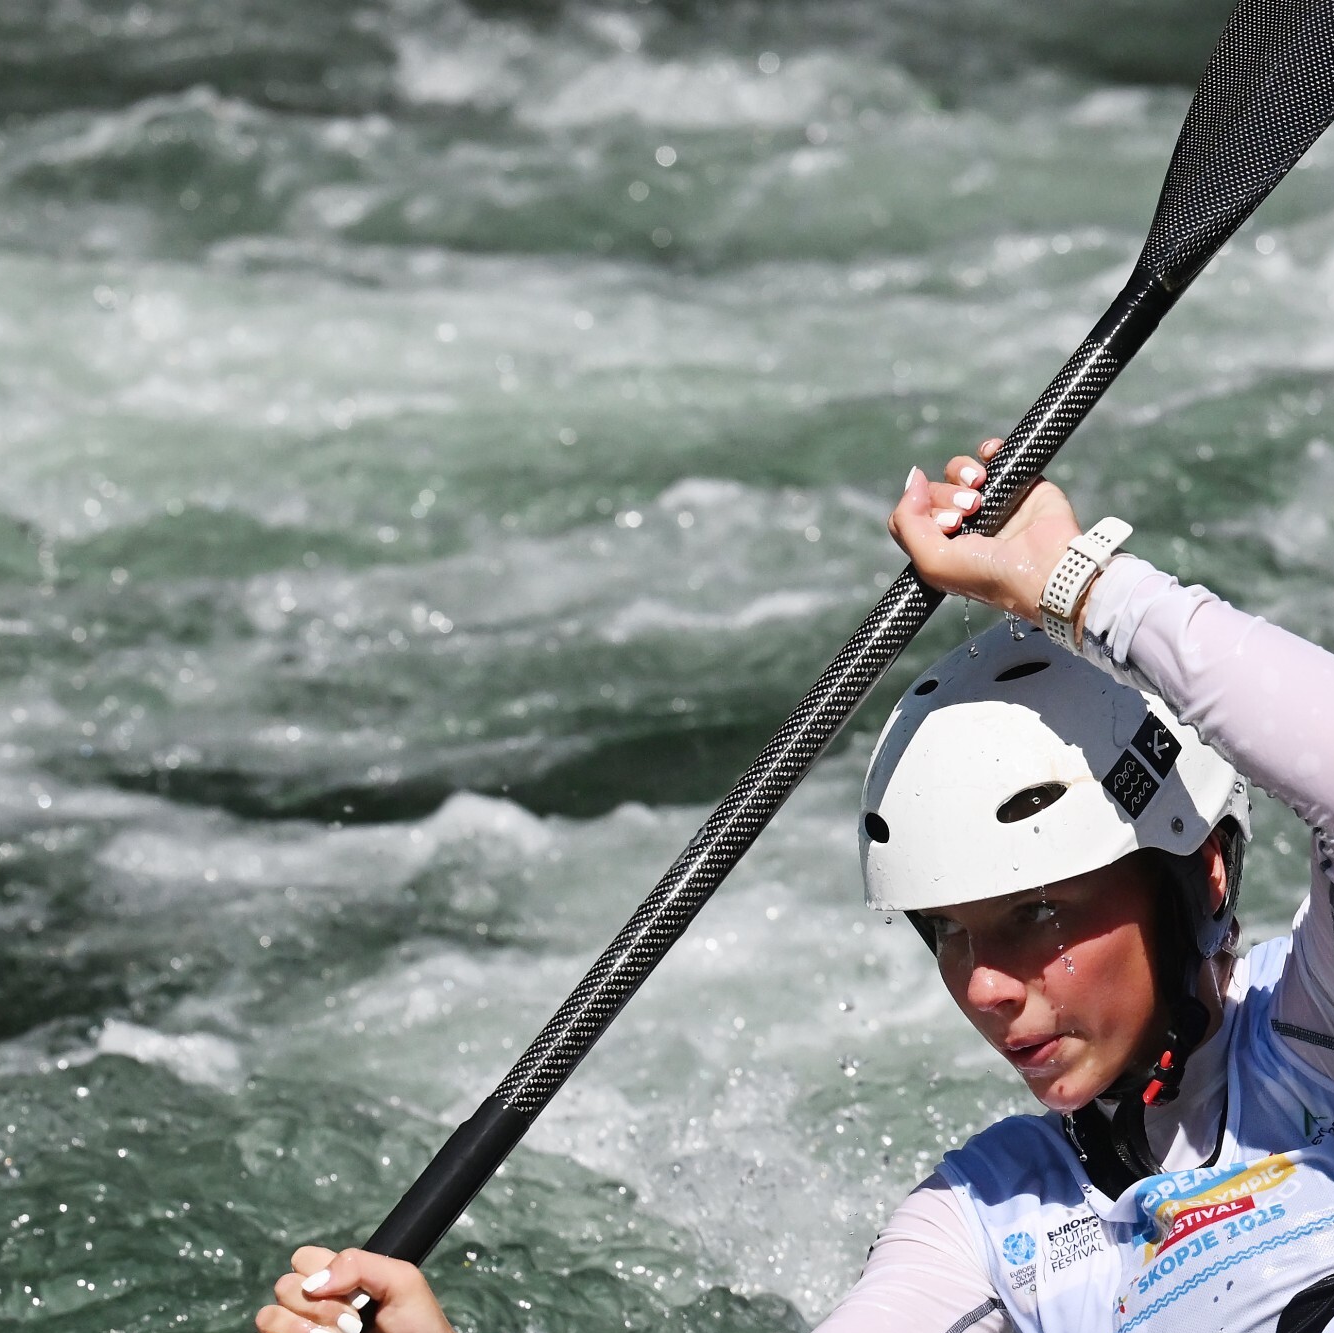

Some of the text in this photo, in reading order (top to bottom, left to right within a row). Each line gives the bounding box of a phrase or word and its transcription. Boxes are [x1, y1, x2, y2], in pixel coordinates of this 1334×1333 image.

[1186, 1163, 1284, 1207] OLYMPIC
[1168, 1201, 1244, 1239] ESTIVAL
[1049, 1229, 1103, 1261] OLYMPIC
[1051, 1226, 1090, 1247] OUTH
[1137, 1230, 1219, 1294] SKOPJE
[1223, 1203, 1286, 1239] 2025
[1010, 1263, 1037, 1278] EUROPE
[1051, 1242, 1105, 1273] FESTIVAL
[1015, 1270, 1037, 1283] OLYMP
